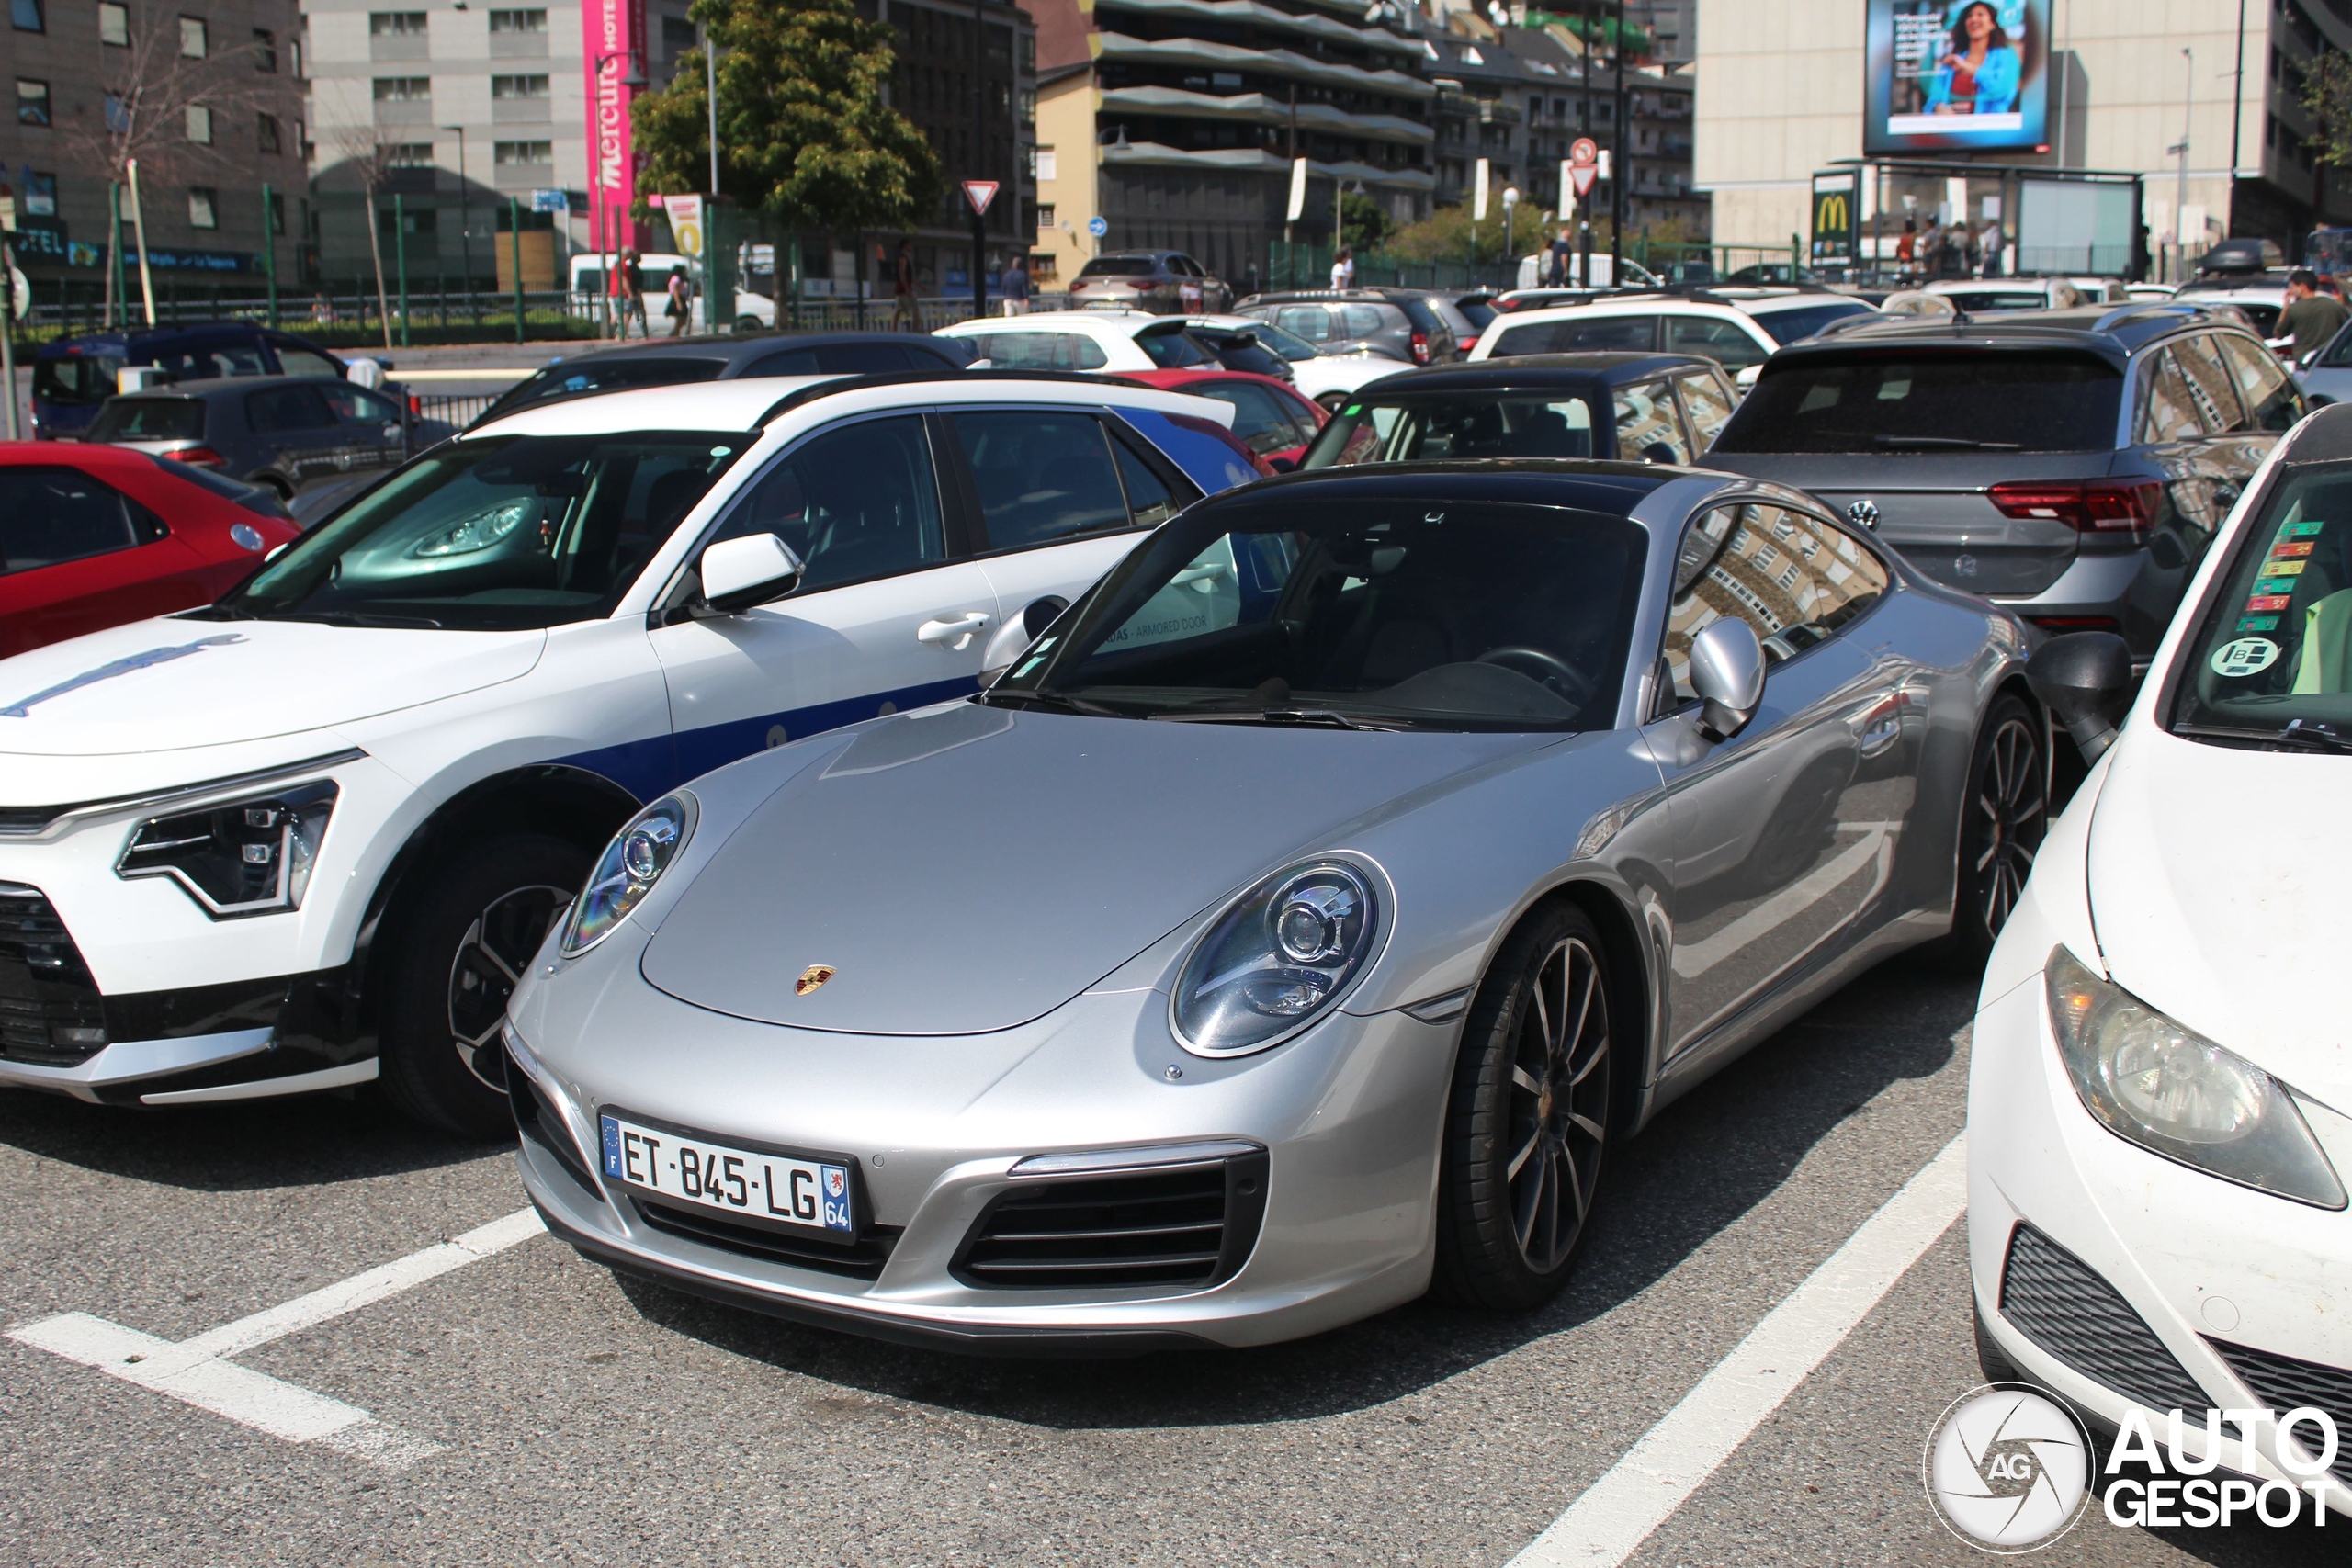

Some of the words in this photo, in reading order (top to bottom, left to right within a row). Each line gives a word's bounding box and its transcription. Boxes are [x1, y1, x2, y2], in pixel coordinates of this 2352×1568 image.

[1136, 619, 1180, 637] ARMORED
[1182, 615, 1207, 630] DOOR
[2233, 650, 2246, 659] B
[610, 1156, 616, 1169] F
[824, 1201, 848, 1226] 64
